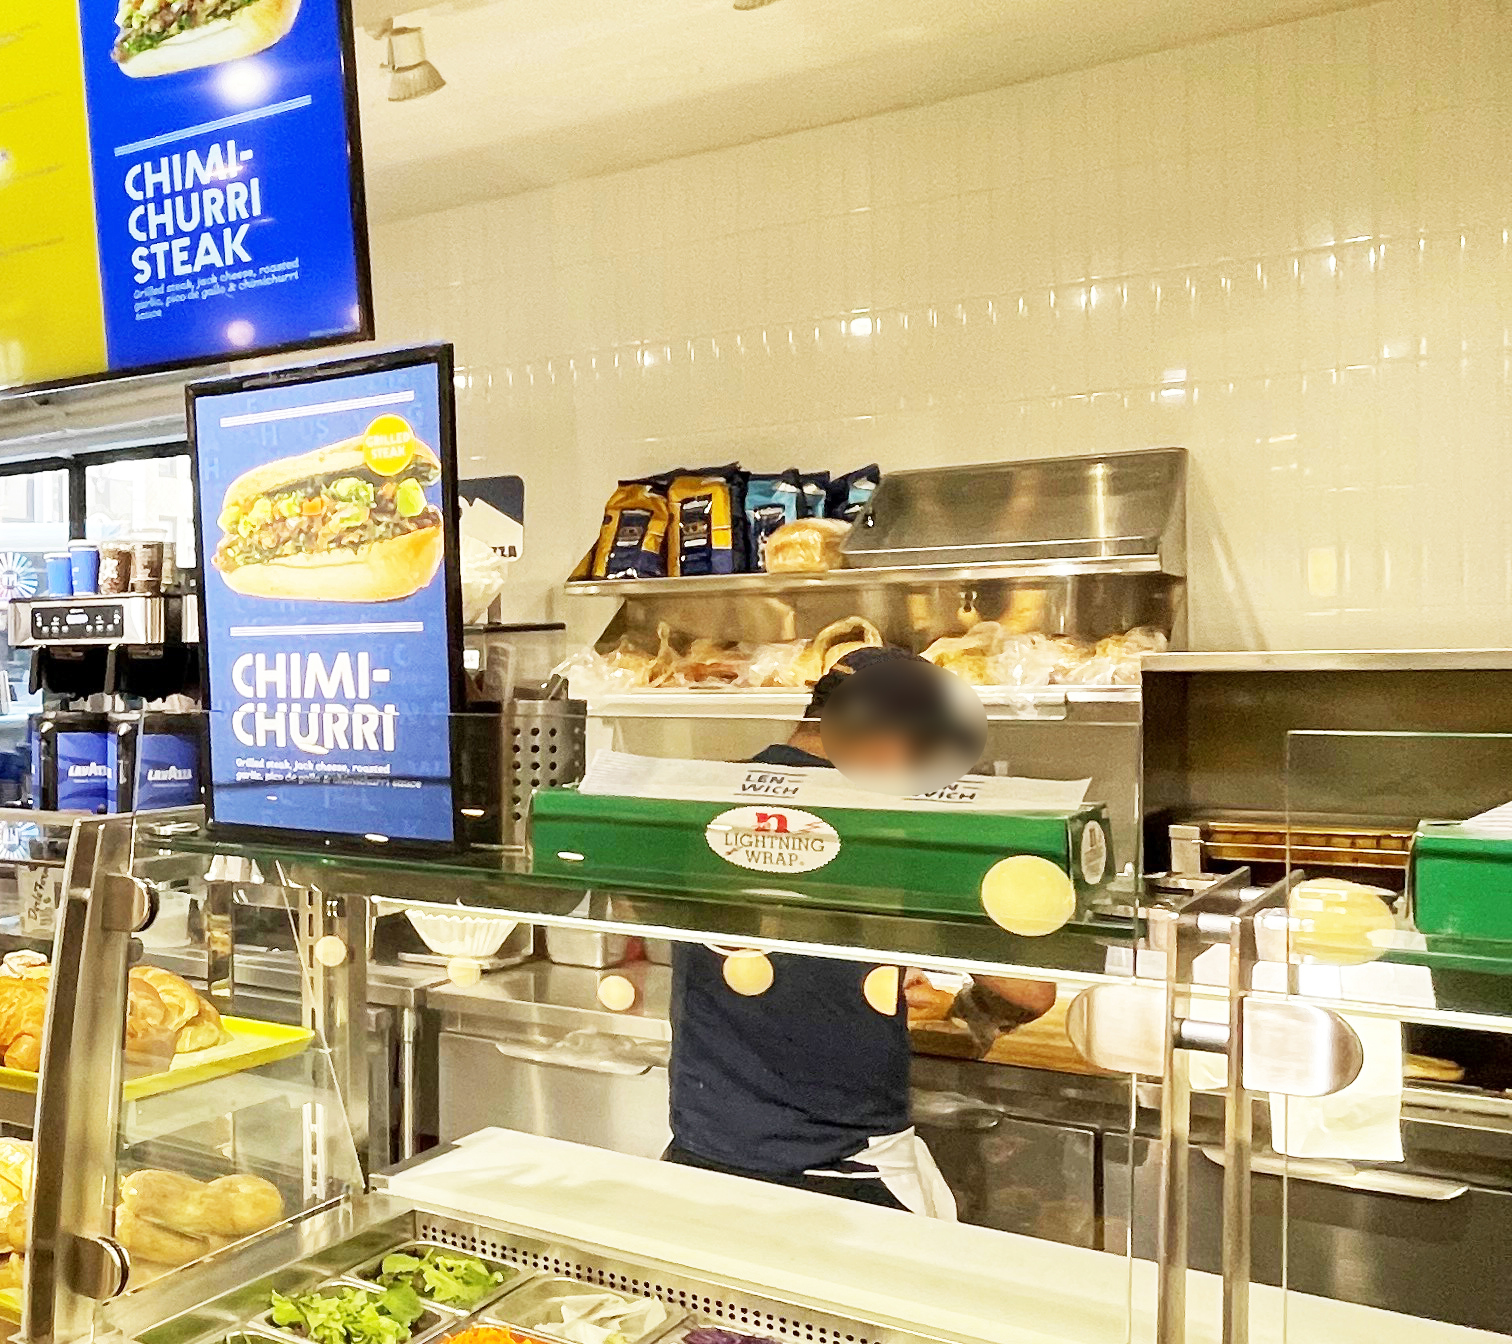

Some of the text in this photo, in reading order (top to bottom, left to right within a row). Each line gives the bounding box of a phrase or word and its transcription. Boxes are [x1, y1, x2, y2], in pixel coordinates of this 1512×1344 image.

[124, 138, 254, 202] CHIMI-
[127, 175, 262, 244] CHURRI
[130, 222, 252, 285] STEAK
[365, 431, 411, 448] GRILLED
[371, 445, 406, 459] STEAK
[230, 650, 393, 702] CHIMI-
[231, 703, 400, 755] CHURRI
[741, 783, 799, 795] WICH
[724, 832, 825, 853] LIGHTNING
